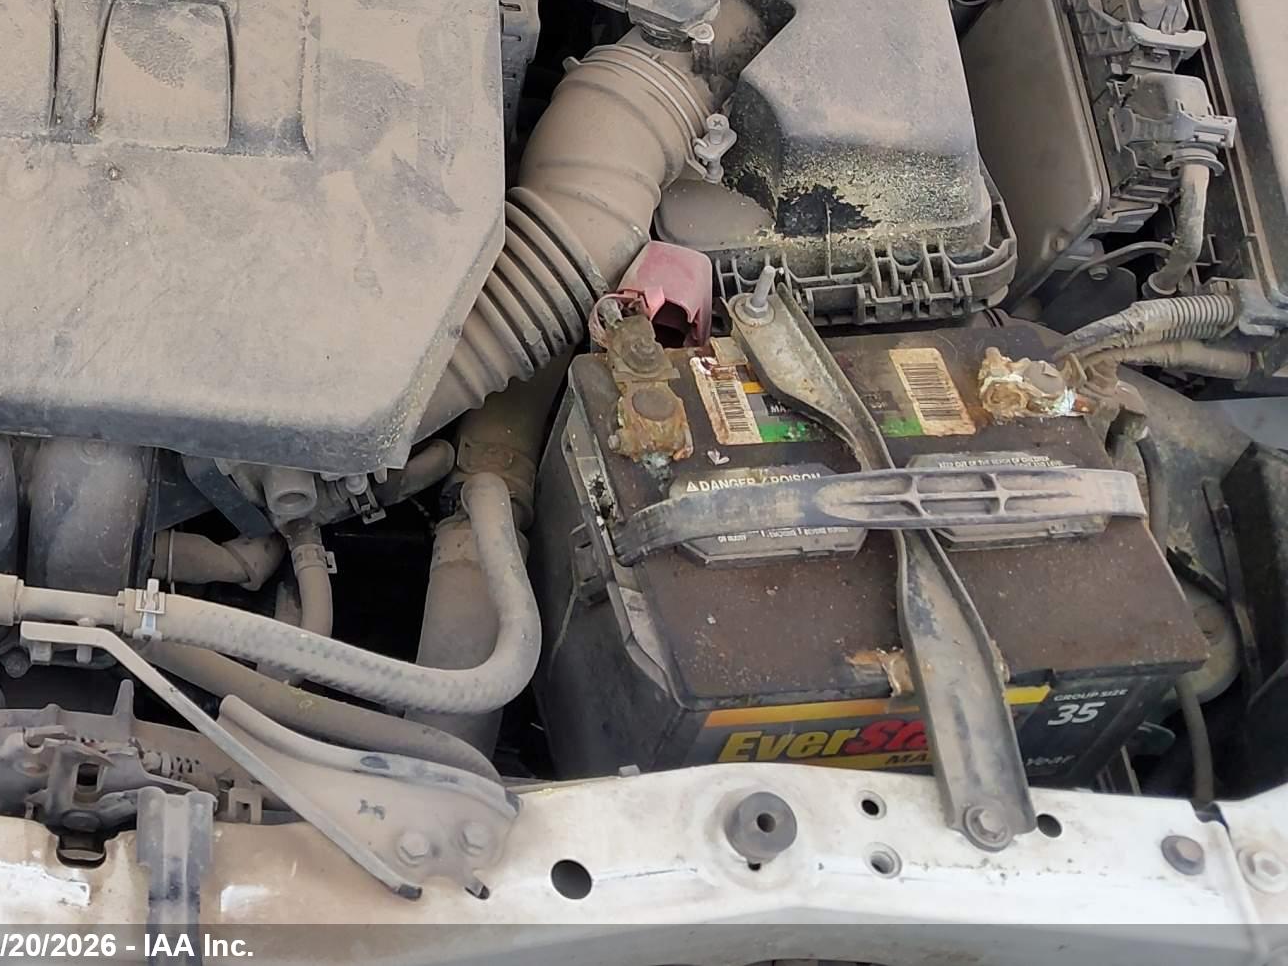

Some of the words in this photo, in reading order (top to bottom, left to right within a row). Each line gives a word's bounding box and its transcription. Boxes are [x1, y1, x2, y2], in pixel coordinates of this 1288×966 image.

[699, 477, 756, 491] DANGER
[1053, 691, 1099, 702] GROUP
[1100, 689, 1129, 698] SIZE
[1047, 701, 1107, 726] 35
